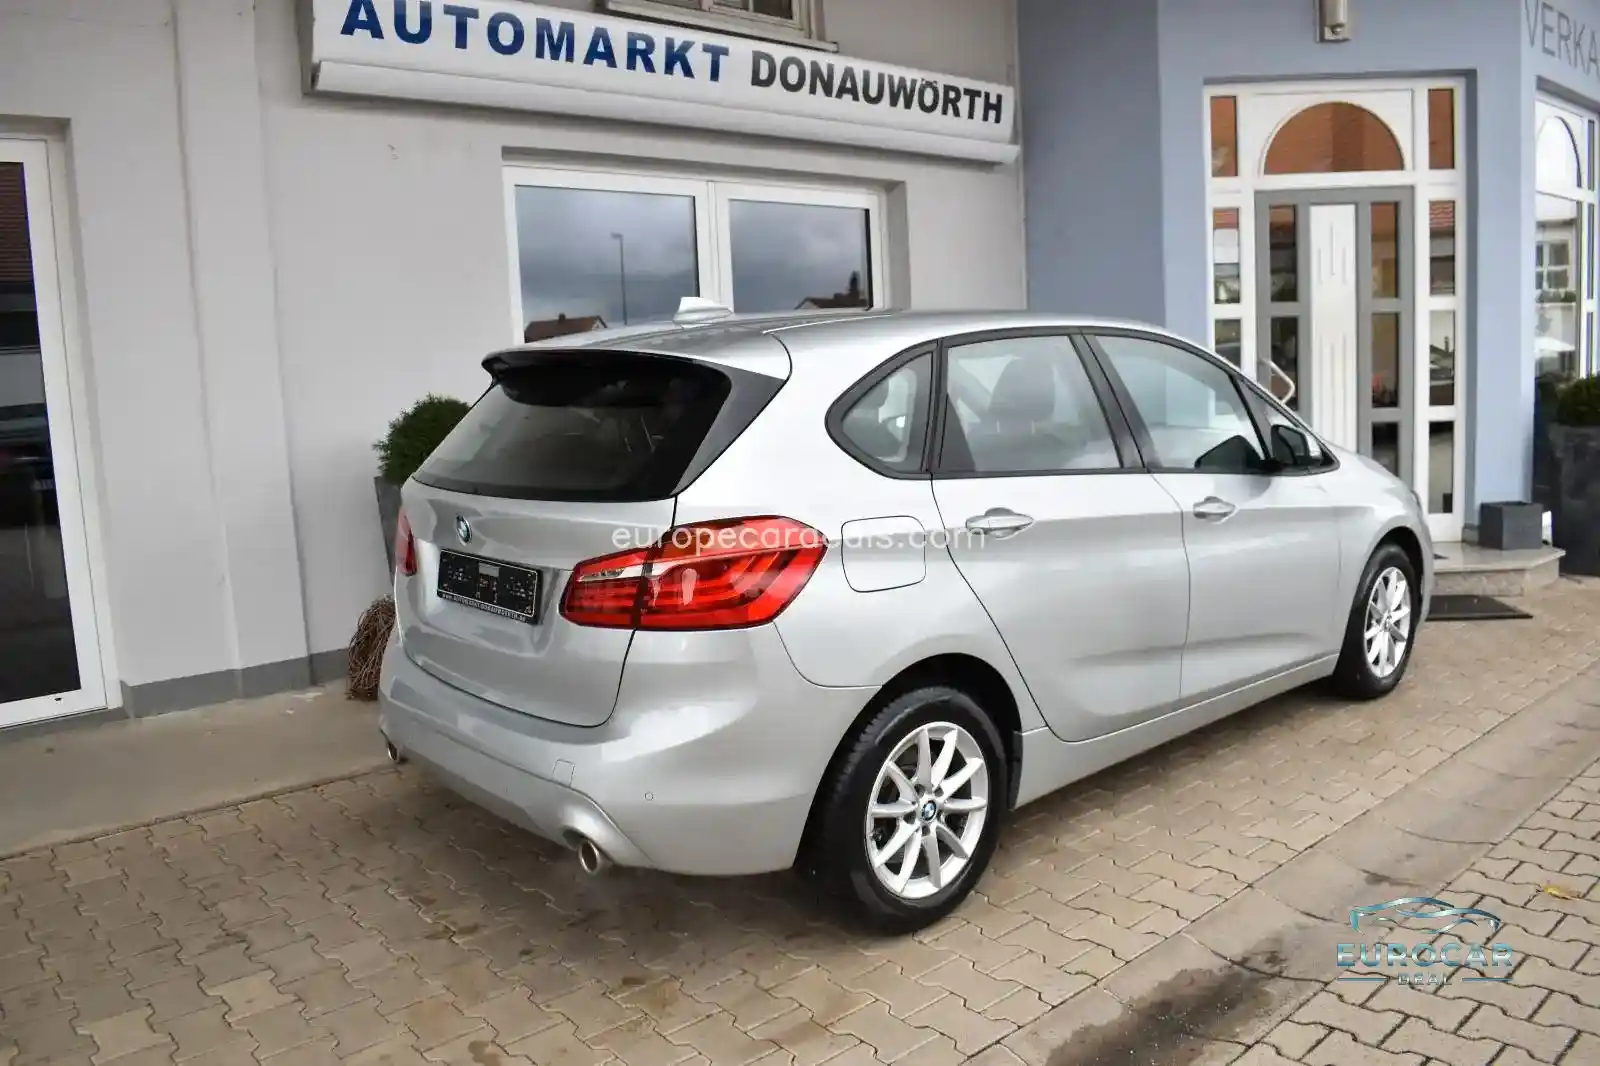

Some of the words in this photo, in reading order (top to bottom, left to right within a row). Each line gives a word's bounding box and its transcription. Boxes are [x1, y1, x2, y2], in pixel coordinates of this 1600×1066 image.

[341, 0, 729, 82] AUTOMARKT
[751, 50, 1003, 124] DONAUWÖRTH
[1525, 0, 1600, 82] VERKA
